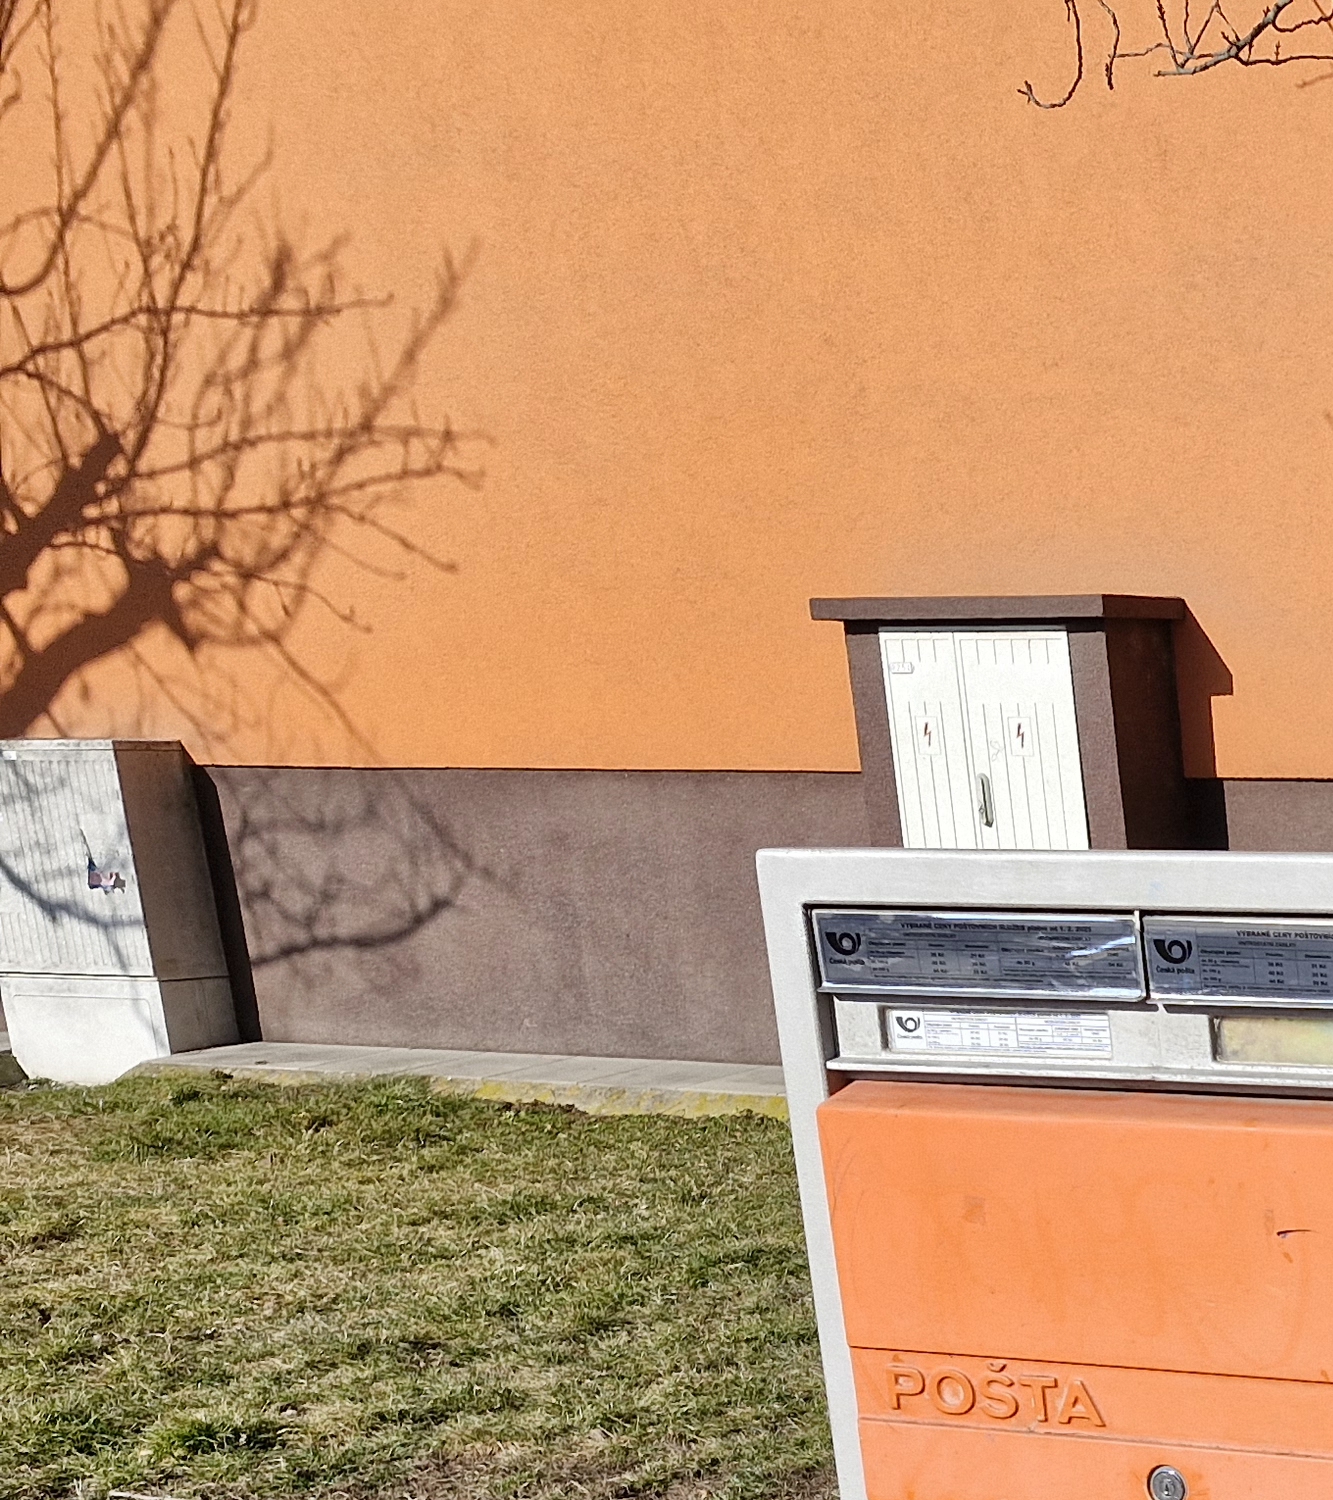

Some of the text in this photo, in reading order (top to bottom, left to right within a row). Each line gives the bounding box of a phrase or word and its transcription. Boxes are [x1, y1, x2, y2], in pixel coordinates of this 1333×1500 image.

[1156, 964, 1195, 975] Česká pošta
[885, 1361, 1106, 1428] POŠTA
